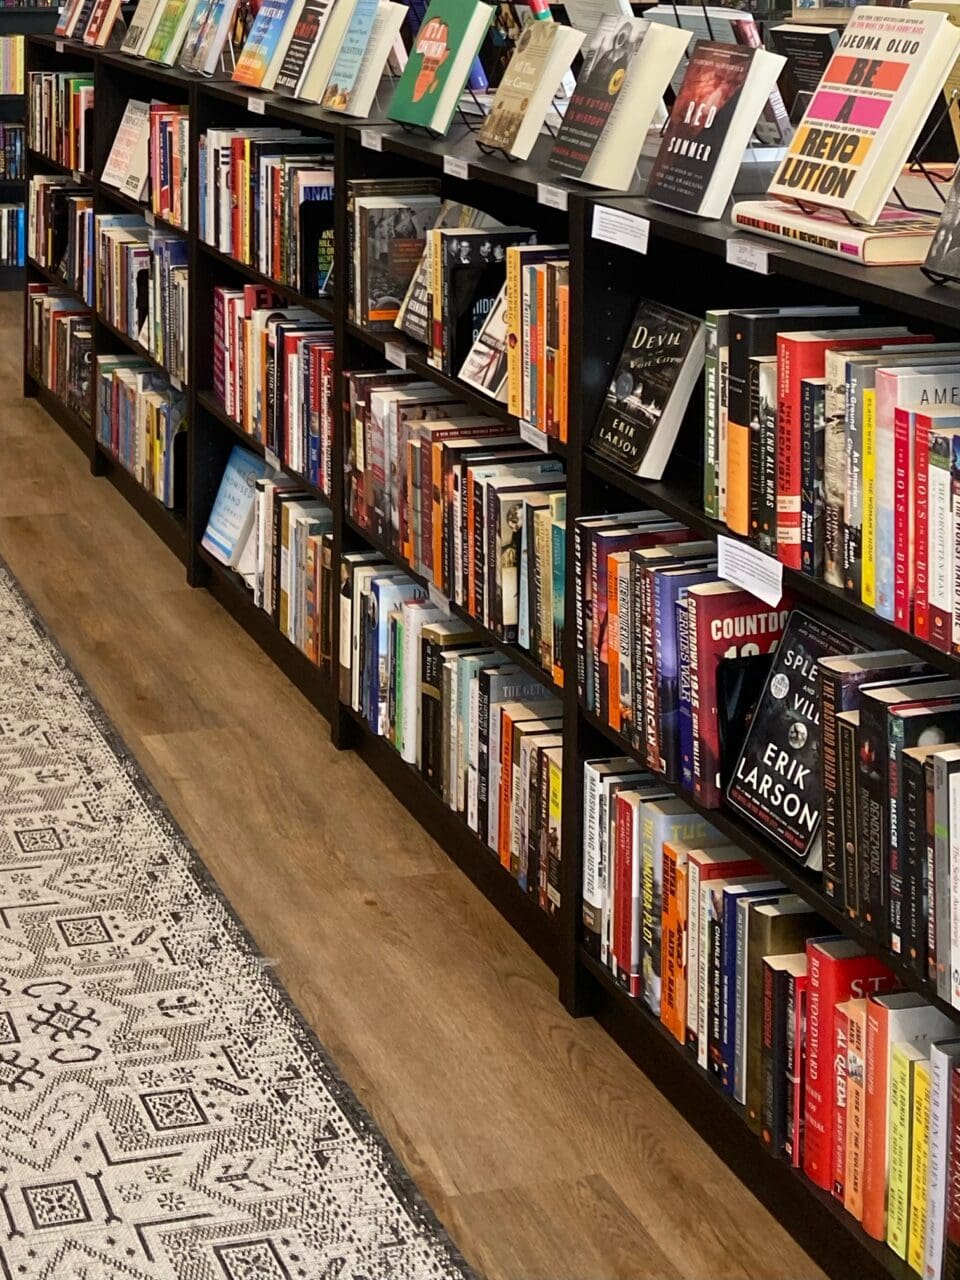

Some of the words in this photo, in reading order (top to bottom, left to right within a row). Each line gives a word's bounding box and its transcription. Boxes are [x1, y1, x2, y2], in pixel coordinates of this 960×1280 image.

[840, 35, 881, 51] IJEOMA
[887, 38, 920, 55] OLUO
[848, 57, 884, 88] BE
[683, 101, 718, 129] RED
[835, 94, 857, 124] A
[667, 136, 712, 162] SUMMER
[800, 128, 860, 164] REVO
[776, 157, 856, 199] LUTION
[632, 326, 681, 349] DEVIL
[612, 418, 634, 438] ERIK
[766, 416, 774, 429] TO
[599, 427, 638, 456] LARSON
[766, 432, 774, 452] END
[766, 456, 774, 474] ALL
[766, 479, 774, 508] WARS
[896, 468, 905, 512] BOYS
[917, 473, 926, 520] BOYS
[575, 561, 581, 574] IN
[619, 576, 629, 593] THE
[896, 552, 905, 598] BOAT
[917, 561, 926, 609] BOAT
[619, 594, 629, 657] CONQUERORS
[688, 598, 697, 670] COUNTDOWN
[643, 625, 652, 664] HALF
[644, 667, 656, 746] AMERICAN
[690, 673, 699, 709] 1945
[823, 679, 834, 701] THE
[823, 702, 835, 745] BASTARD
[763, 742, 812, 790] ERIK
[824, 746, 836, 793] BRIGADE
[587, 776, 597, 849] MARSHALLING
[736, 756, 820, 833] LARSON
[826, 795, 835, 827] SAM
[826, 830, 836, 871] KEAN
[870, 800, 880, 876] RENDEZVOUS
[587, 851, 595, 896] JUSTICE
[643, 843, 653, 910] LUMUMBA
[643, 911, 652, 947] PLOT
[811, 957, 819, 988] BOB
[810, 992, 819, 1080] WOODWARD
